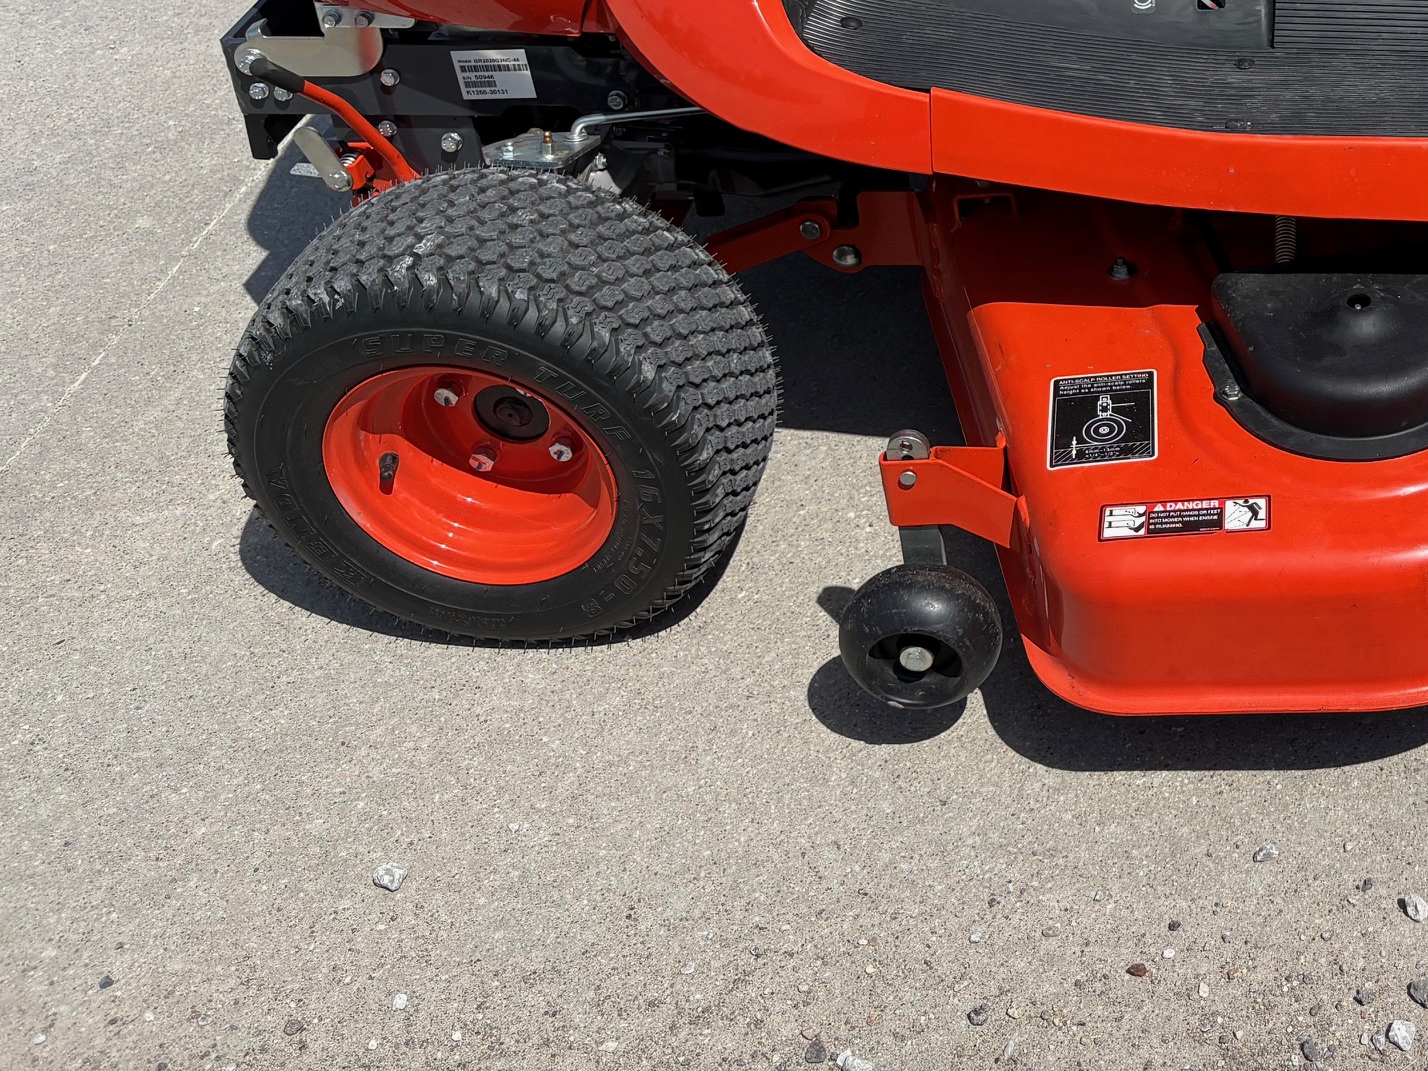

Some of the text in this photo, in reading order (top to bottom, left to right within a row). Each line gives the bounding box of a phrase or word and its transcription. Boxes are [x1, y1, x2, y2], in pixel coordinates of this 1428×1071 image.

[362, 333, 631, 441] SUPER TURF
[265, 465, 367, 586] KENDA
[1166, 499, 1219, 511] DANGER
